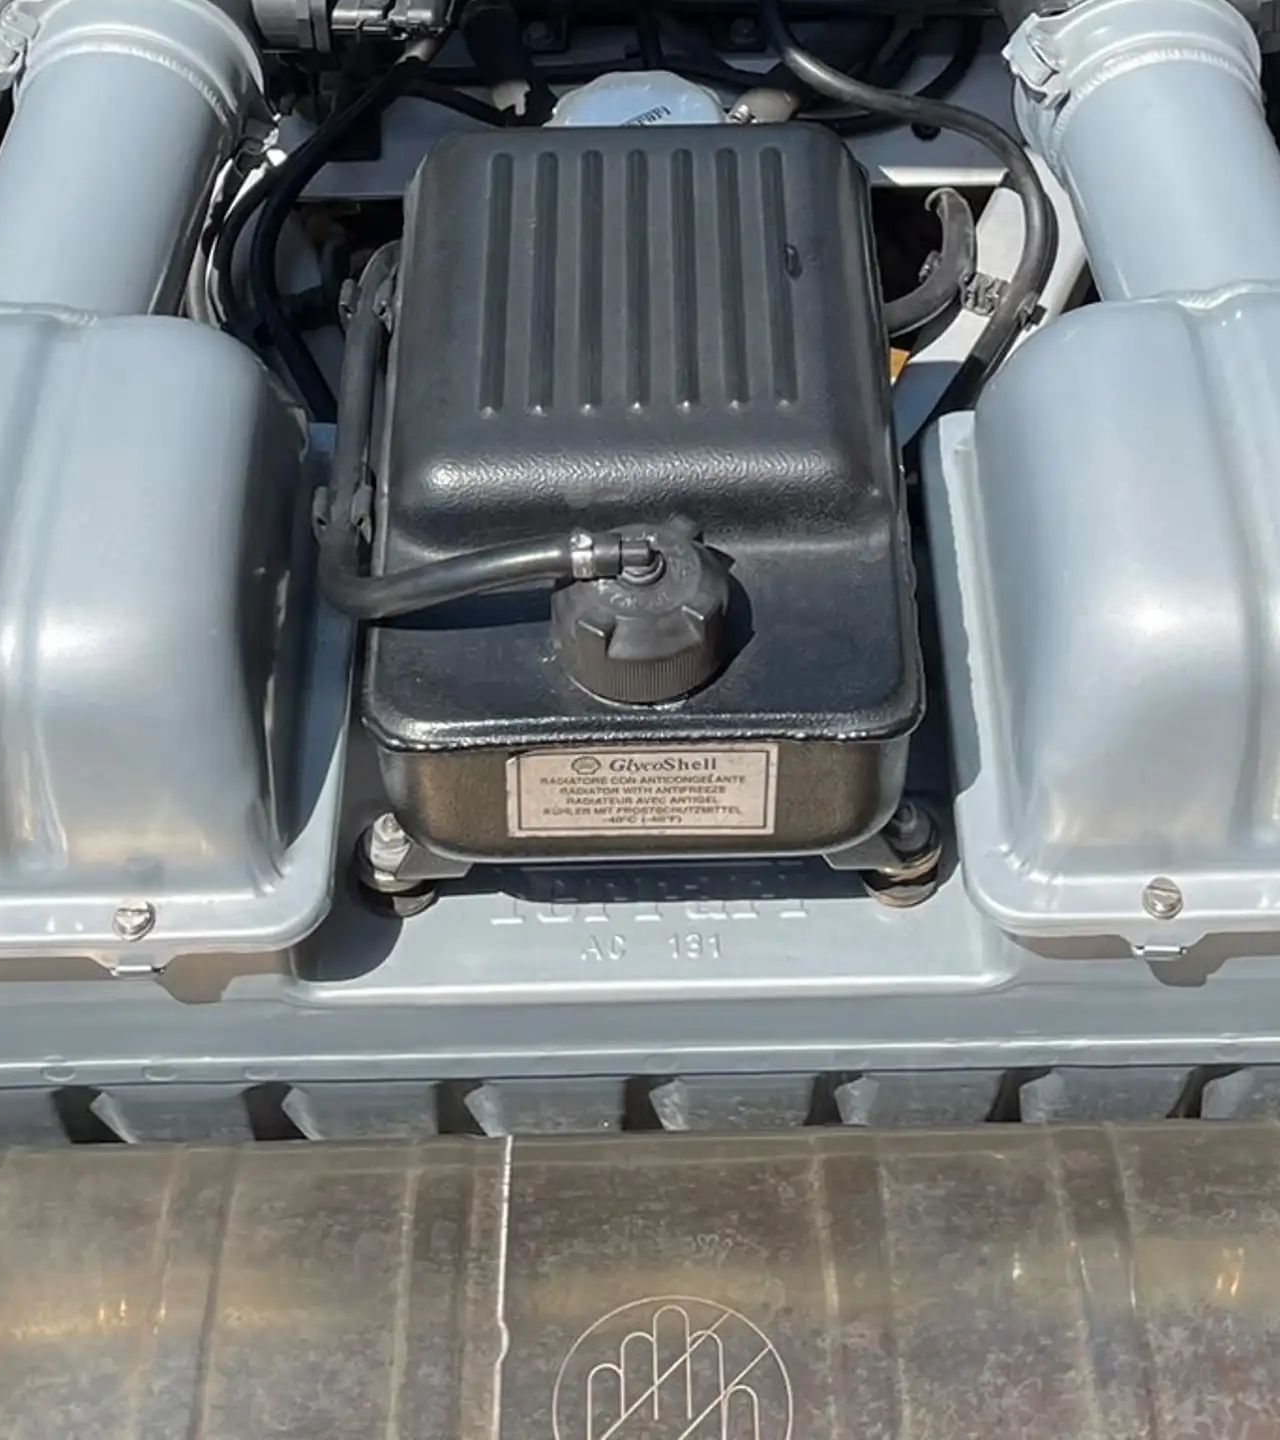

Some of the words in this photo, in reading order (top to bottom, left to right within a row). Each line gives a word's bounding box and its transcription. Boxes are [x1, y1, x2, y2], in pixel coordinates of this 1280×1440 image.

[608, 755, 716, 774] GlycoShell
[559, 787, 619, 795] RADIATOR
[656, 786, 726, 794] ANTIFREEZE
